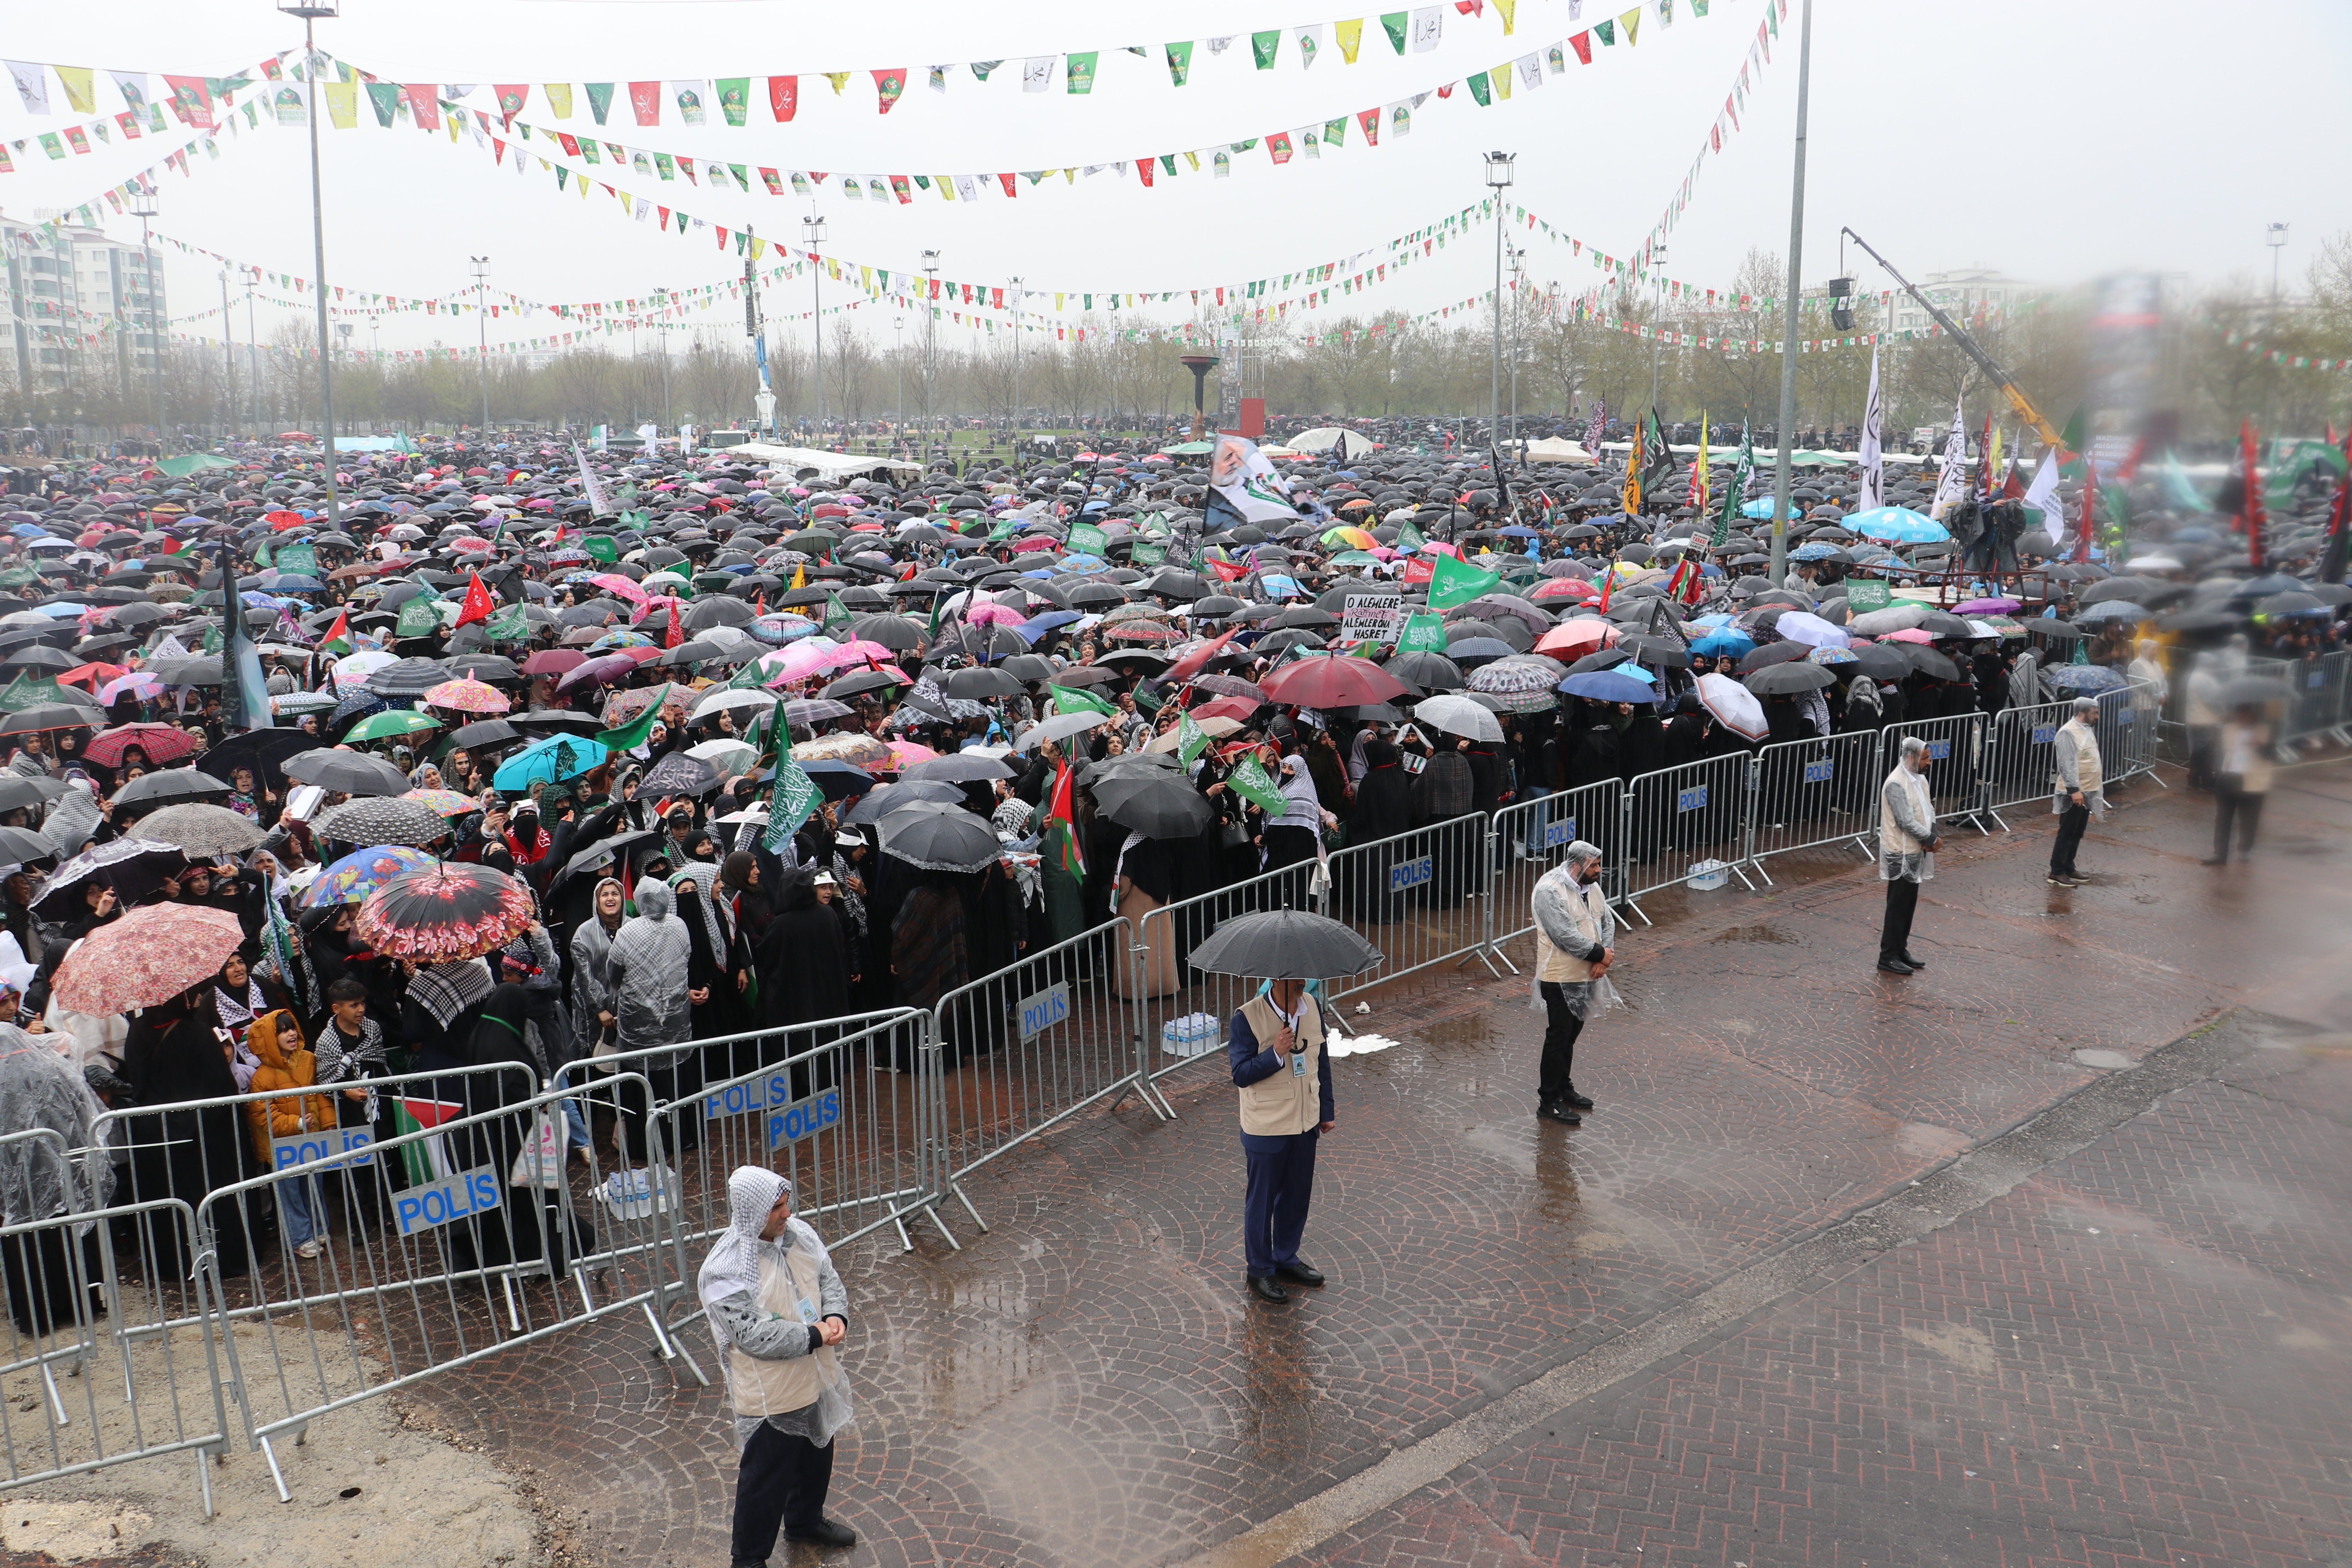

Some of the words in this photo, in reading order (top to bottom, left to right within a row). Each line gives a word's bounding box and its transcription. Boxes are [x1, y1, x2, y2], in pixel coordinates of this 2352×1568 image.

[1045, 63, 1054, 84] SEVDALILARI
[1347, 597, 1355, 608] O
[1357, 597, 1400, 610] ALEMLERE
[1354, 630, 1388, 639] HASRET
[1806, 762, 1833, 782] POLİS
[1680, 788, 1707, 811] POLİS
[1547, 820, 1575, 847] POLİS
[1024, 992, 1065, 1035] POLİS
[398, 1174, 497, 1233] POLİS
